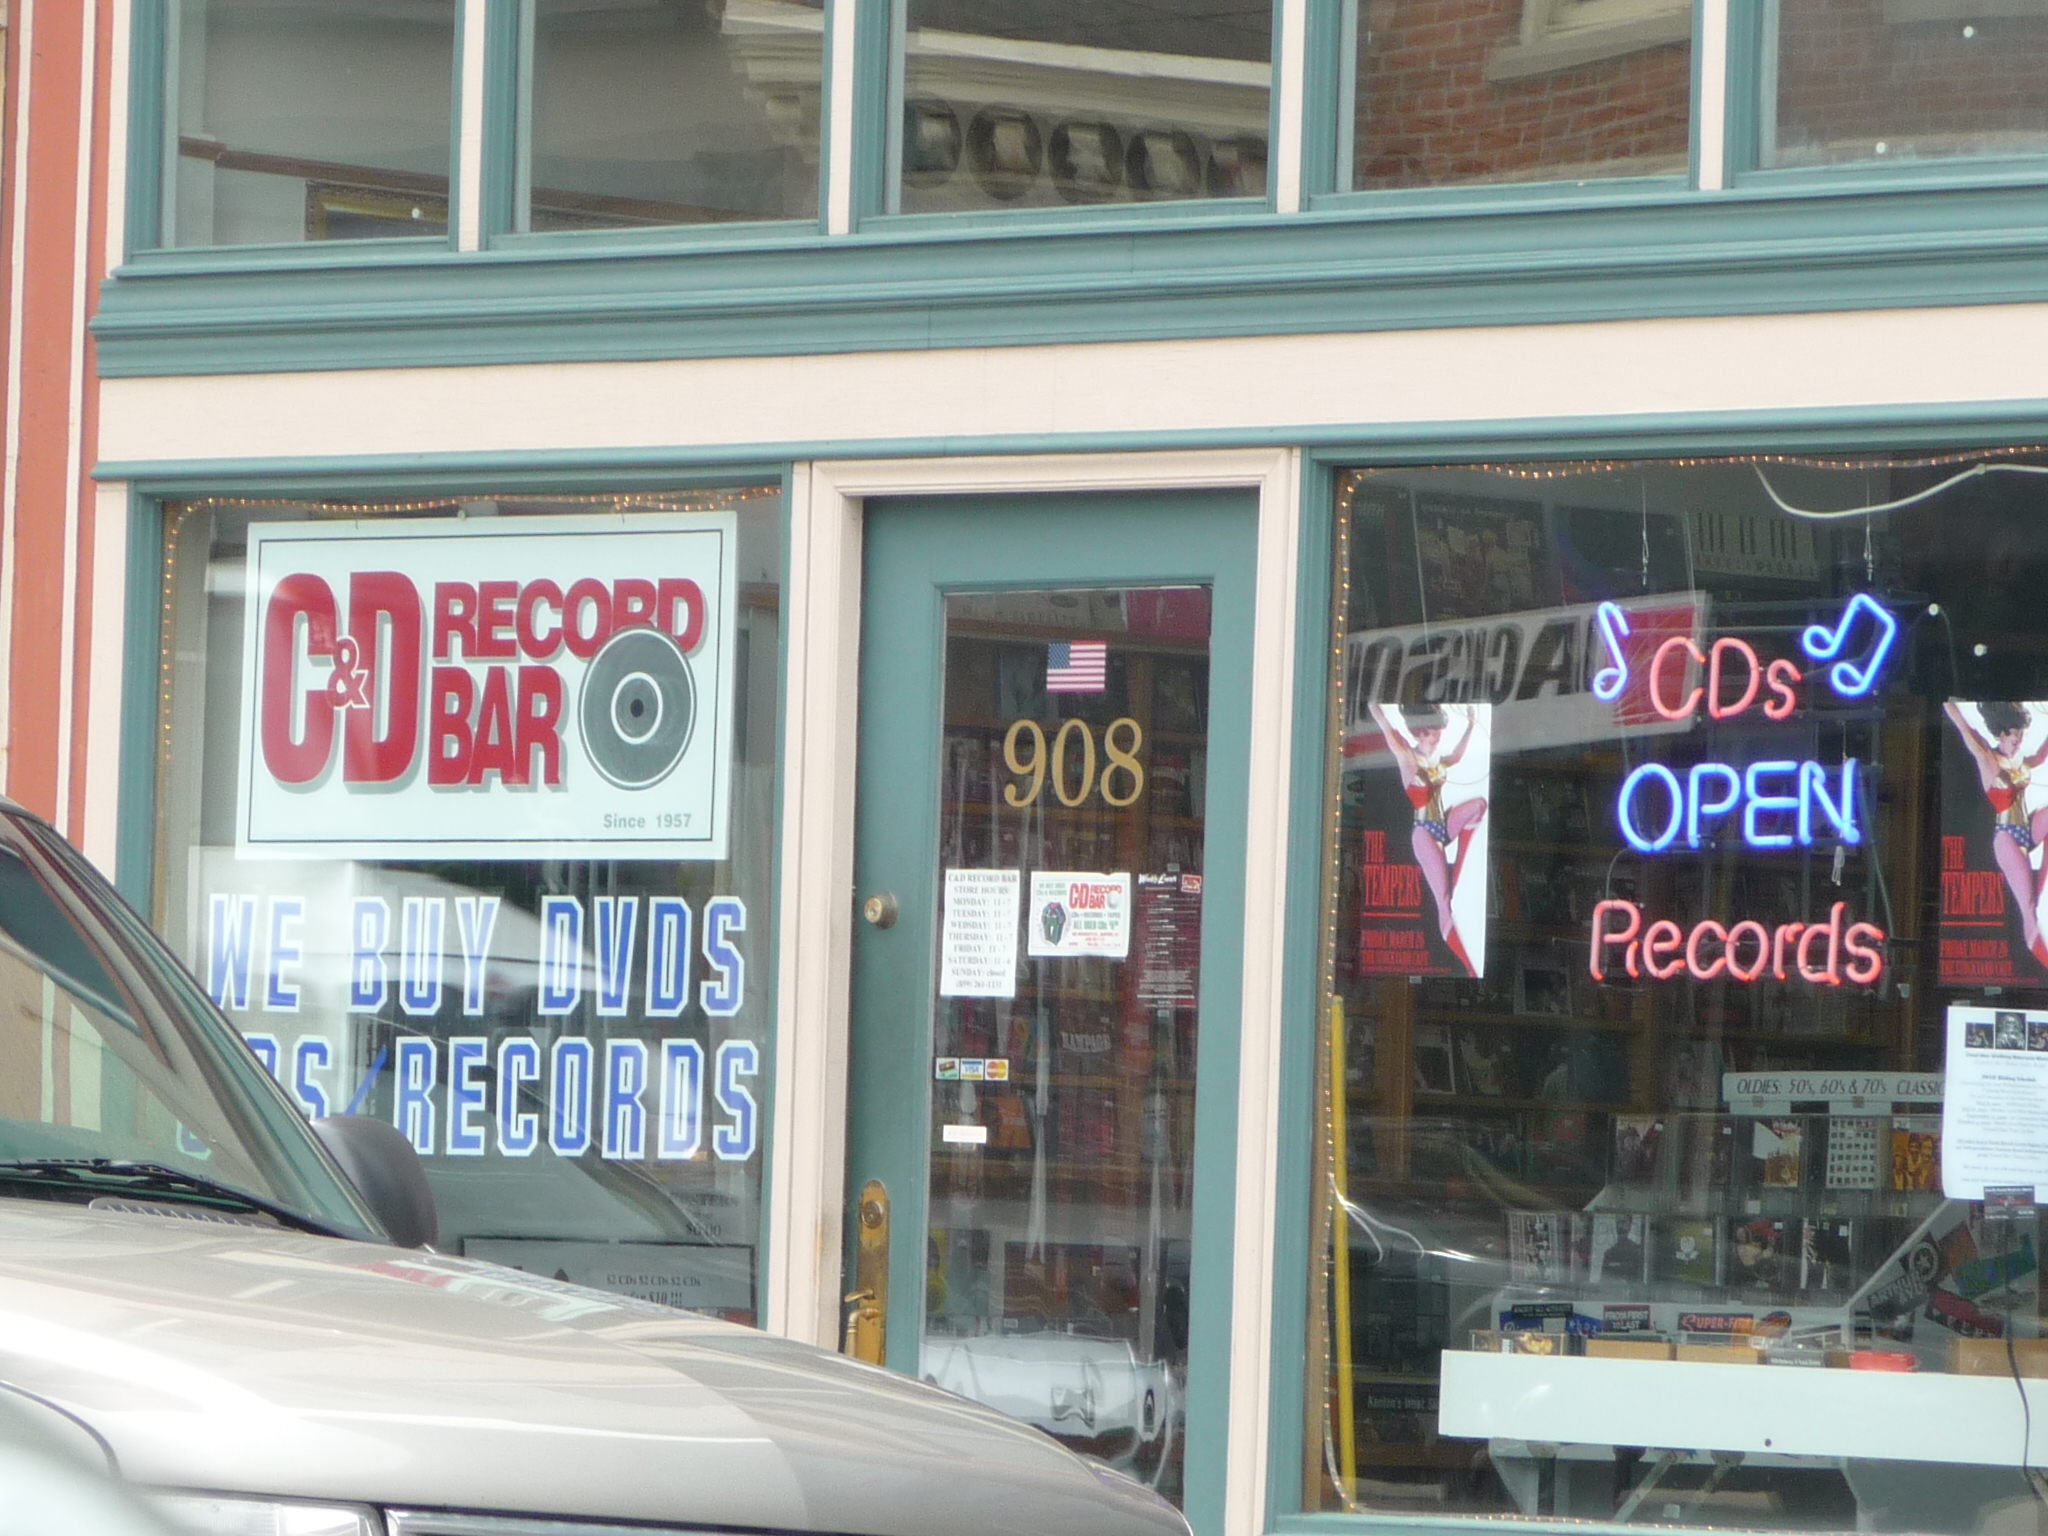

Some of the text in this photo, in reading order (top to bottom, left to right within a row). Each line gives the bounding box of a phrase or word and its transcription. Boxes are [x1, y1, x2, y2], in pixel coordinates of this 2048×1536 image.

[432, 577, 706, 662] RECORD
[1649, 636, 1802, 721] CDs
[427, 664, 567, 791] BAR
[1003, 717, 1145, 808] 908
[603, 812, 692, 829] Since 1957
[1364, 830, 1386, 863] THE
[1617, 757, 1861, 853] OPEN
[954, 886, 978, 894] STORE
[967, 874, 1000, 882] RECORD
[1002, 874, 1018, 883] BAR
[206, 894, 747, 1017] WE BUY DVDS
[1589, 900, 1886, 987] Records
[393, 1036, 760, 1162] RECORDS
[1737, 1079, 1782, 1095] OLDIES:
[1820, 1079, 1846, 1095] 60's
[1849, 1079, 1859, 1094] &
[1863, 1078, 1887, 1095] 70's
[618, 1275, 638, 1286] CDs
[651, 1275, 670, 1287] CDs
